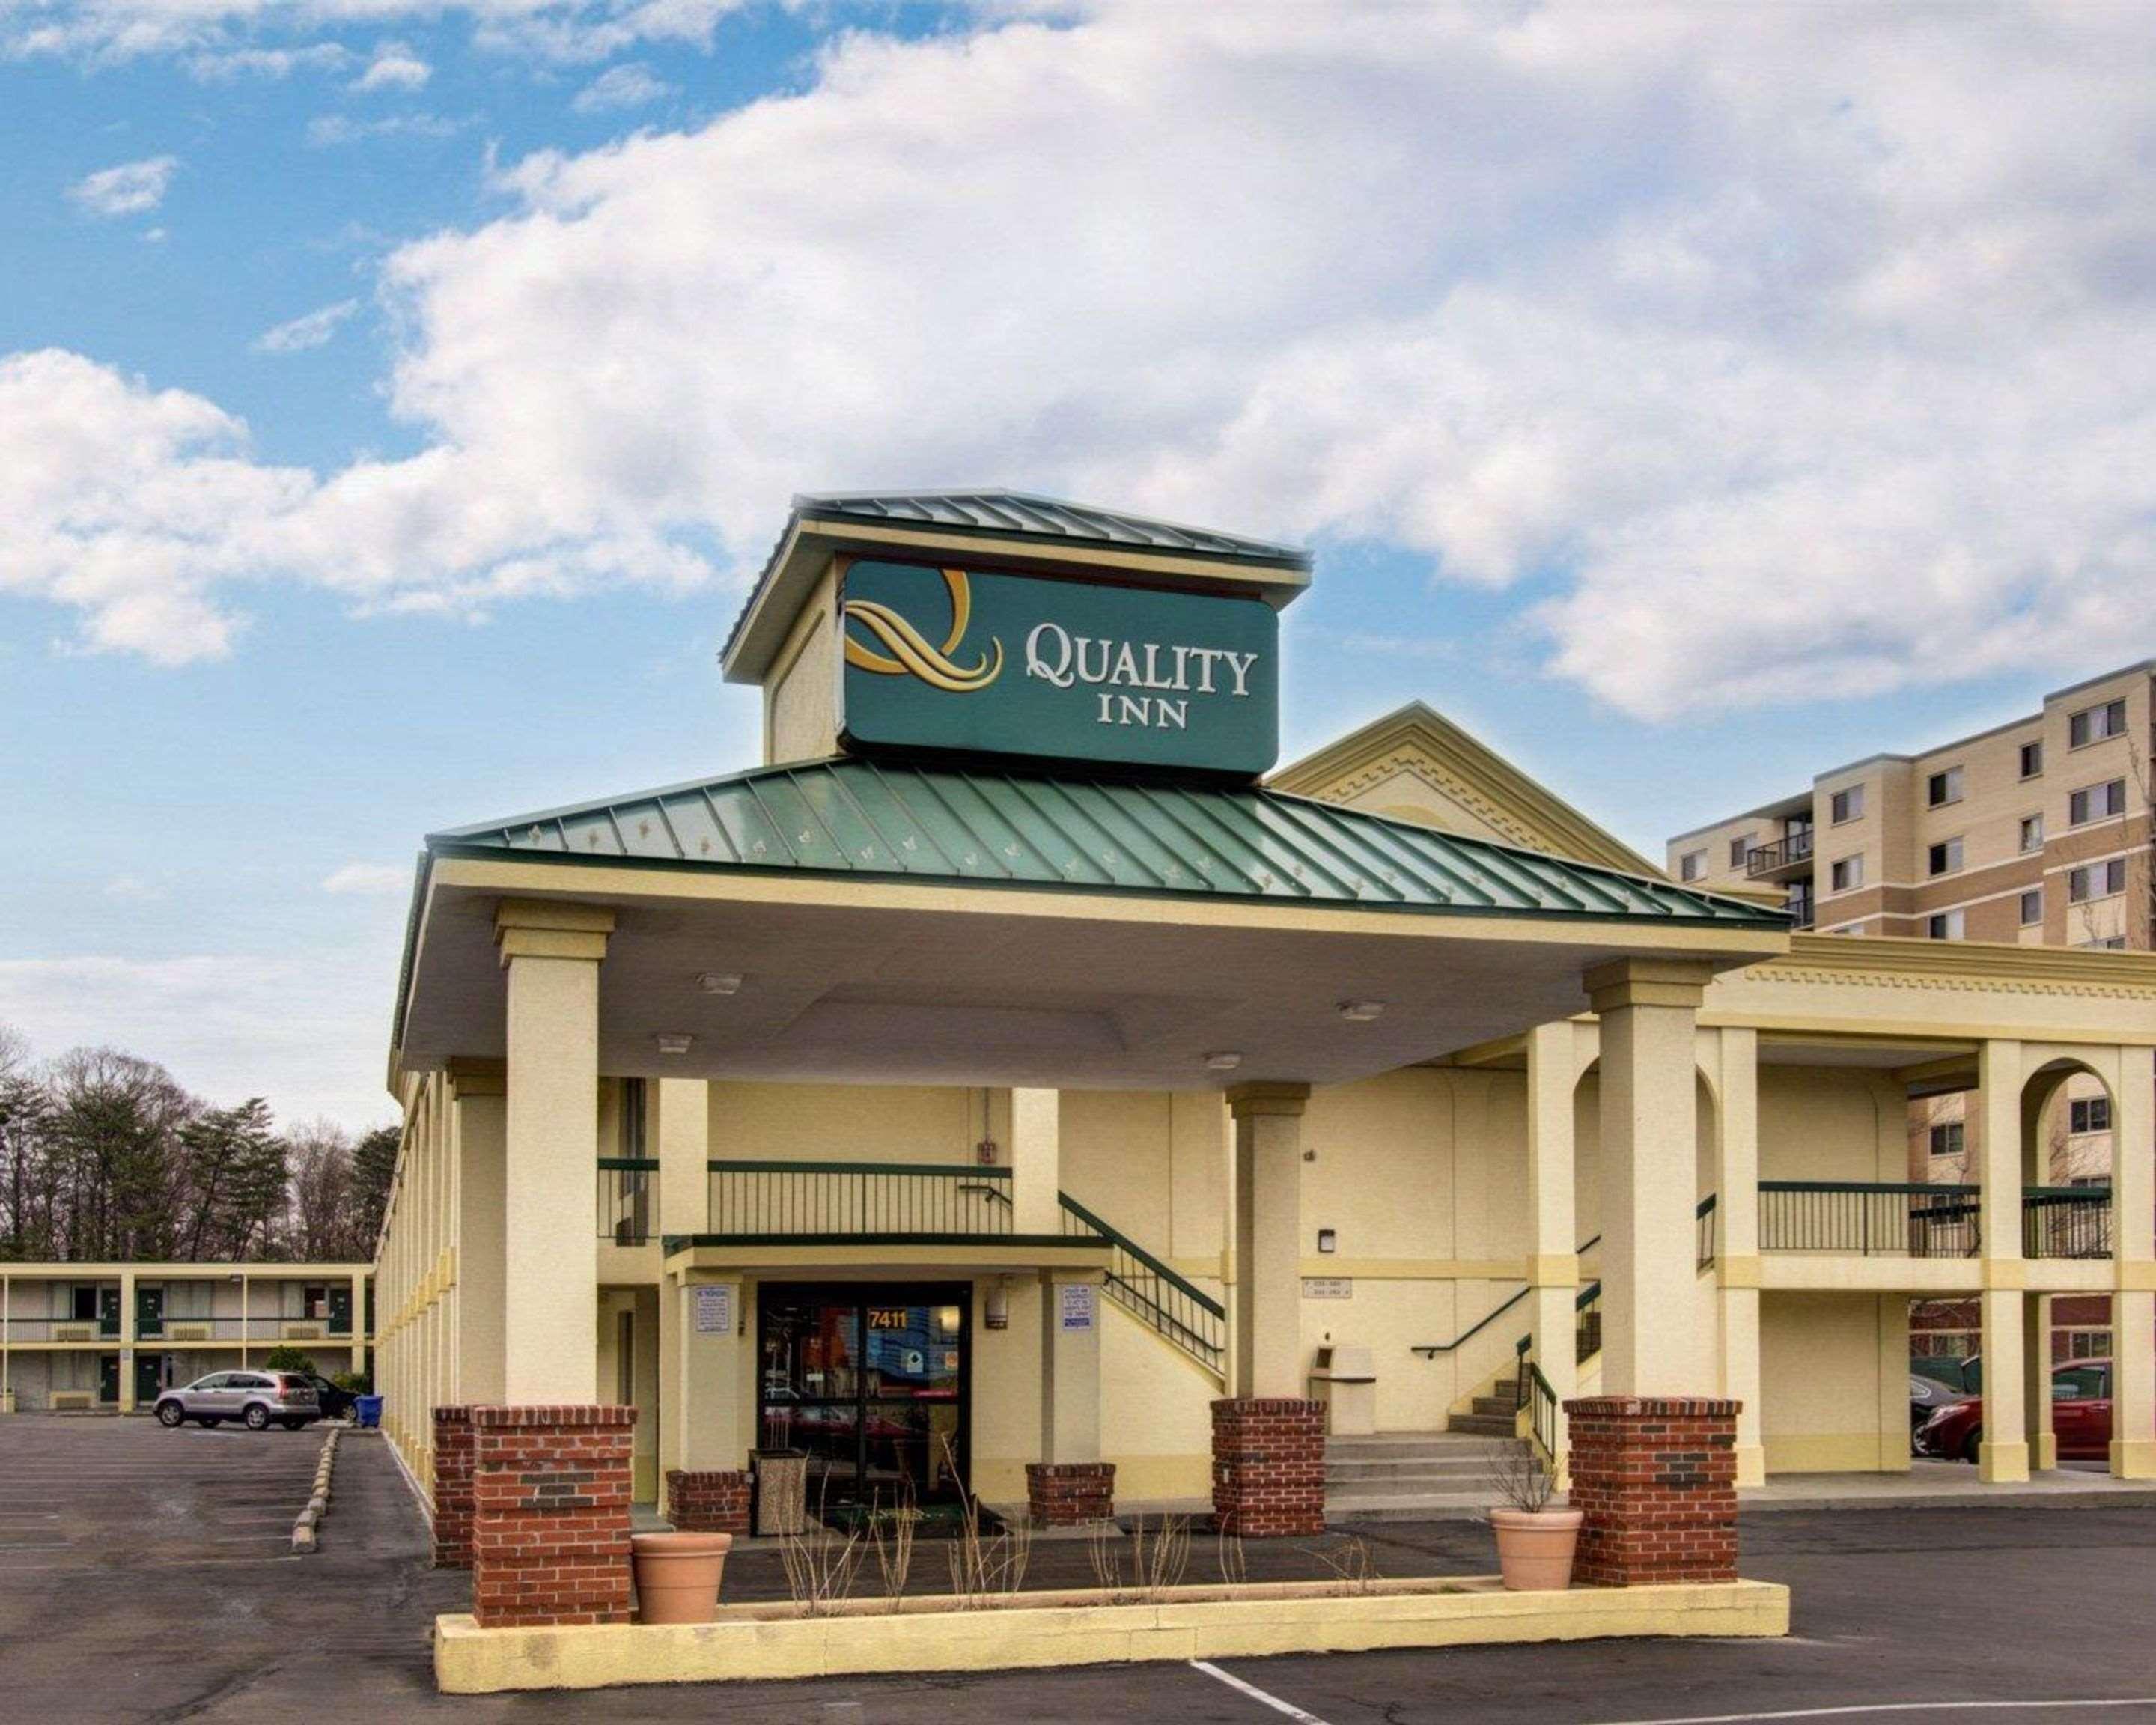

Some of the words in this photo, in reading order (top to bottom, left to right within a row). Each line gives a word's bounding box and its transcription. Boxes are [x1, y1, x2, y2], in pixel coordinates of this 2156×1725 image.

[1026, 622, 1258, 696] QUALITY
[1097, 693, 1189, 729] INN
[870, 1310, 906, 1328] 7411
